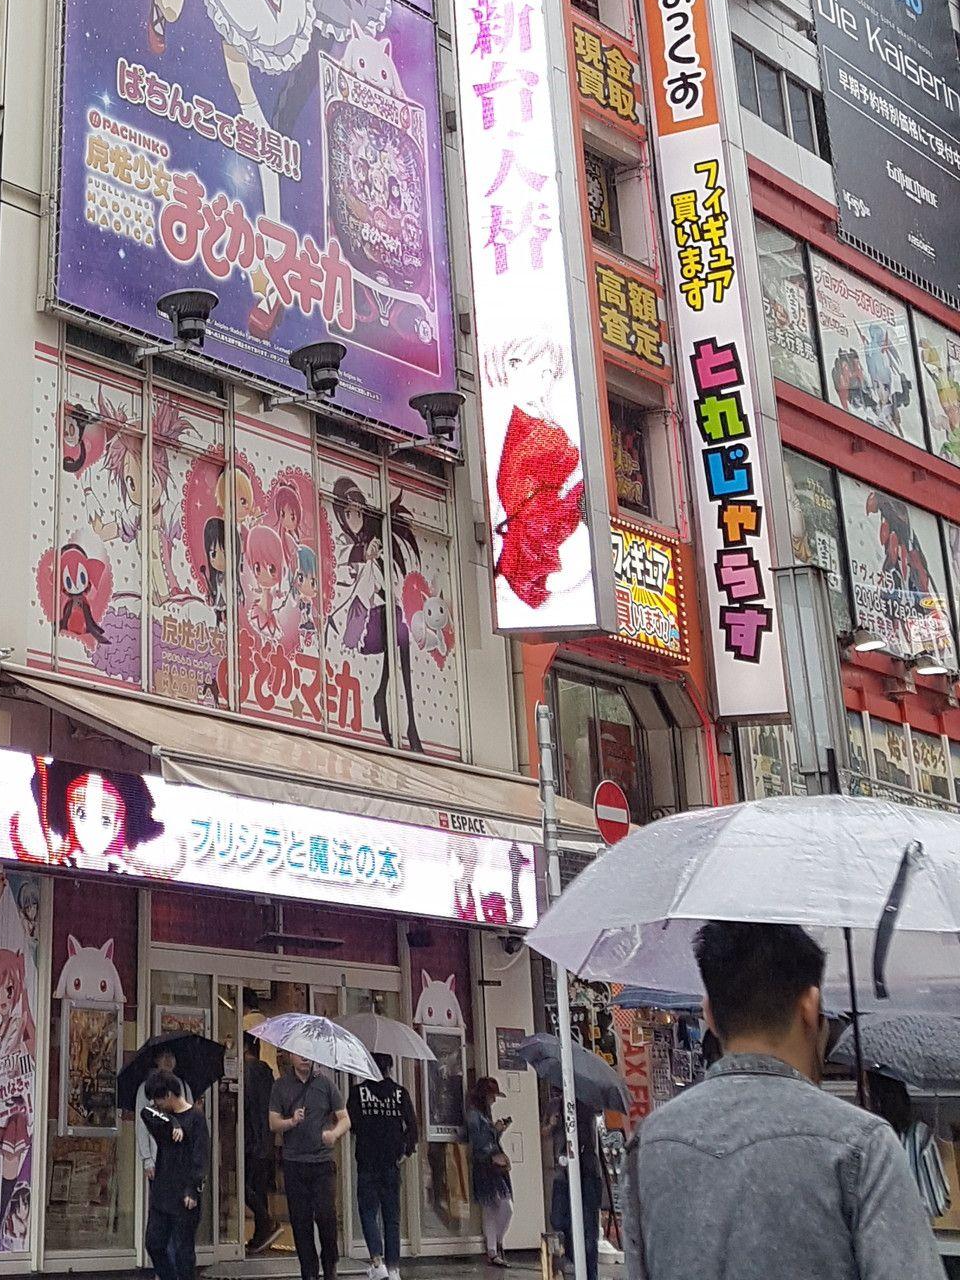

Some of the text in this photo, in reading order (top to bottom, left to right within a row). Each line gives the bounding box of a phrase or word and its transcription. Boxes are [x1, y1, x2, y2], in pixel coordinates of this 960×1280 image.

[574, 27, 633, 88] 現金
[116, 57, 303, 181] ぱちんこで登場!!
[577, 61, 638, 124] 買取
[102, 118, 170, 159] PACHINKO
[670, 189, 708, 312] 買います
[694, 159, 736, 305] フィギュア
[596, 263, 659, 327] 高額
[600, 305, 663, 366] 査定
[450, 814, 486, 834] ESPACE
